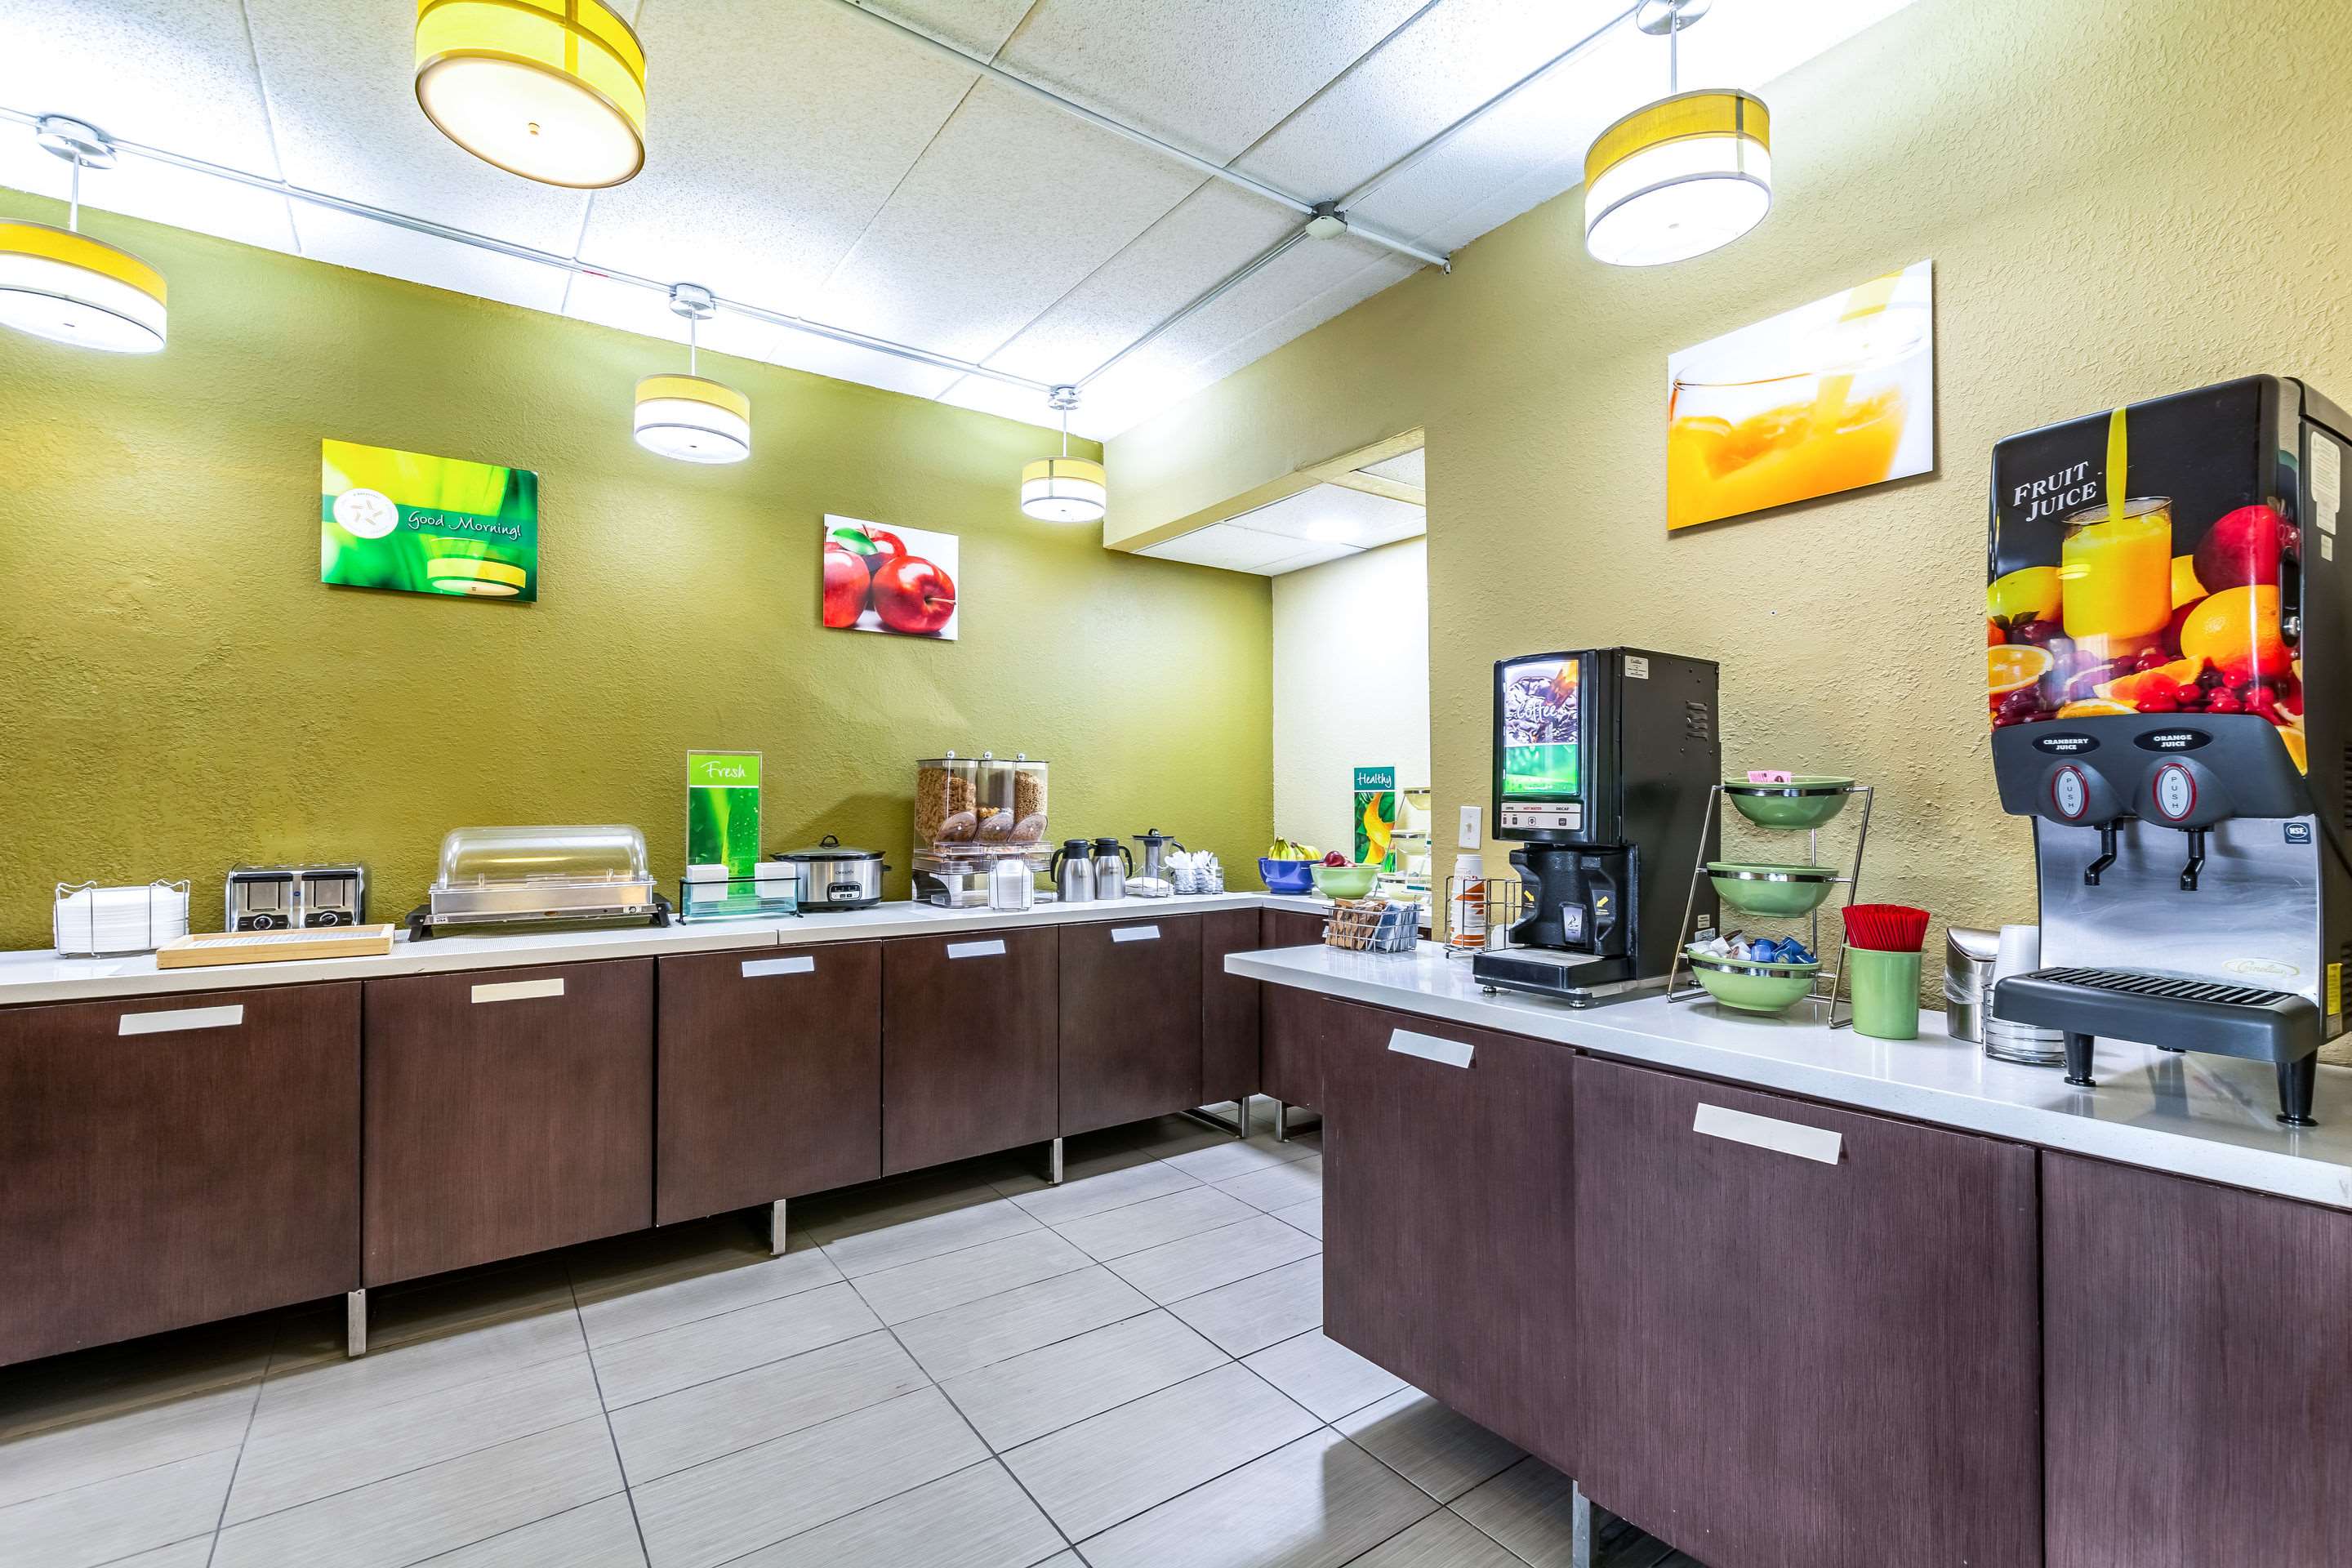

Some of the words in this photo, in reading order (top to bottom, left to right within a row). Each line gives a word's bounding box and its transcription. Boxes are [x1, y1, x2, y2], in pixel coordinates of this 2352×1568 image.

[2012, 461, 2089, 506] FRUIT
[2025, 481, 2097, 522] JUICE
[408, 510, 444, 530] Good
[448, 516, 521, 541] Morning!
[1517, 702, 1558, 723] Coffee
[700, 760, 746, 778] Fresh
[1356, 772, 1392, 789] Healthy
[2066, 777, 2074, 808] PUSH
[2171, 777, 2179, 808] PUSH
